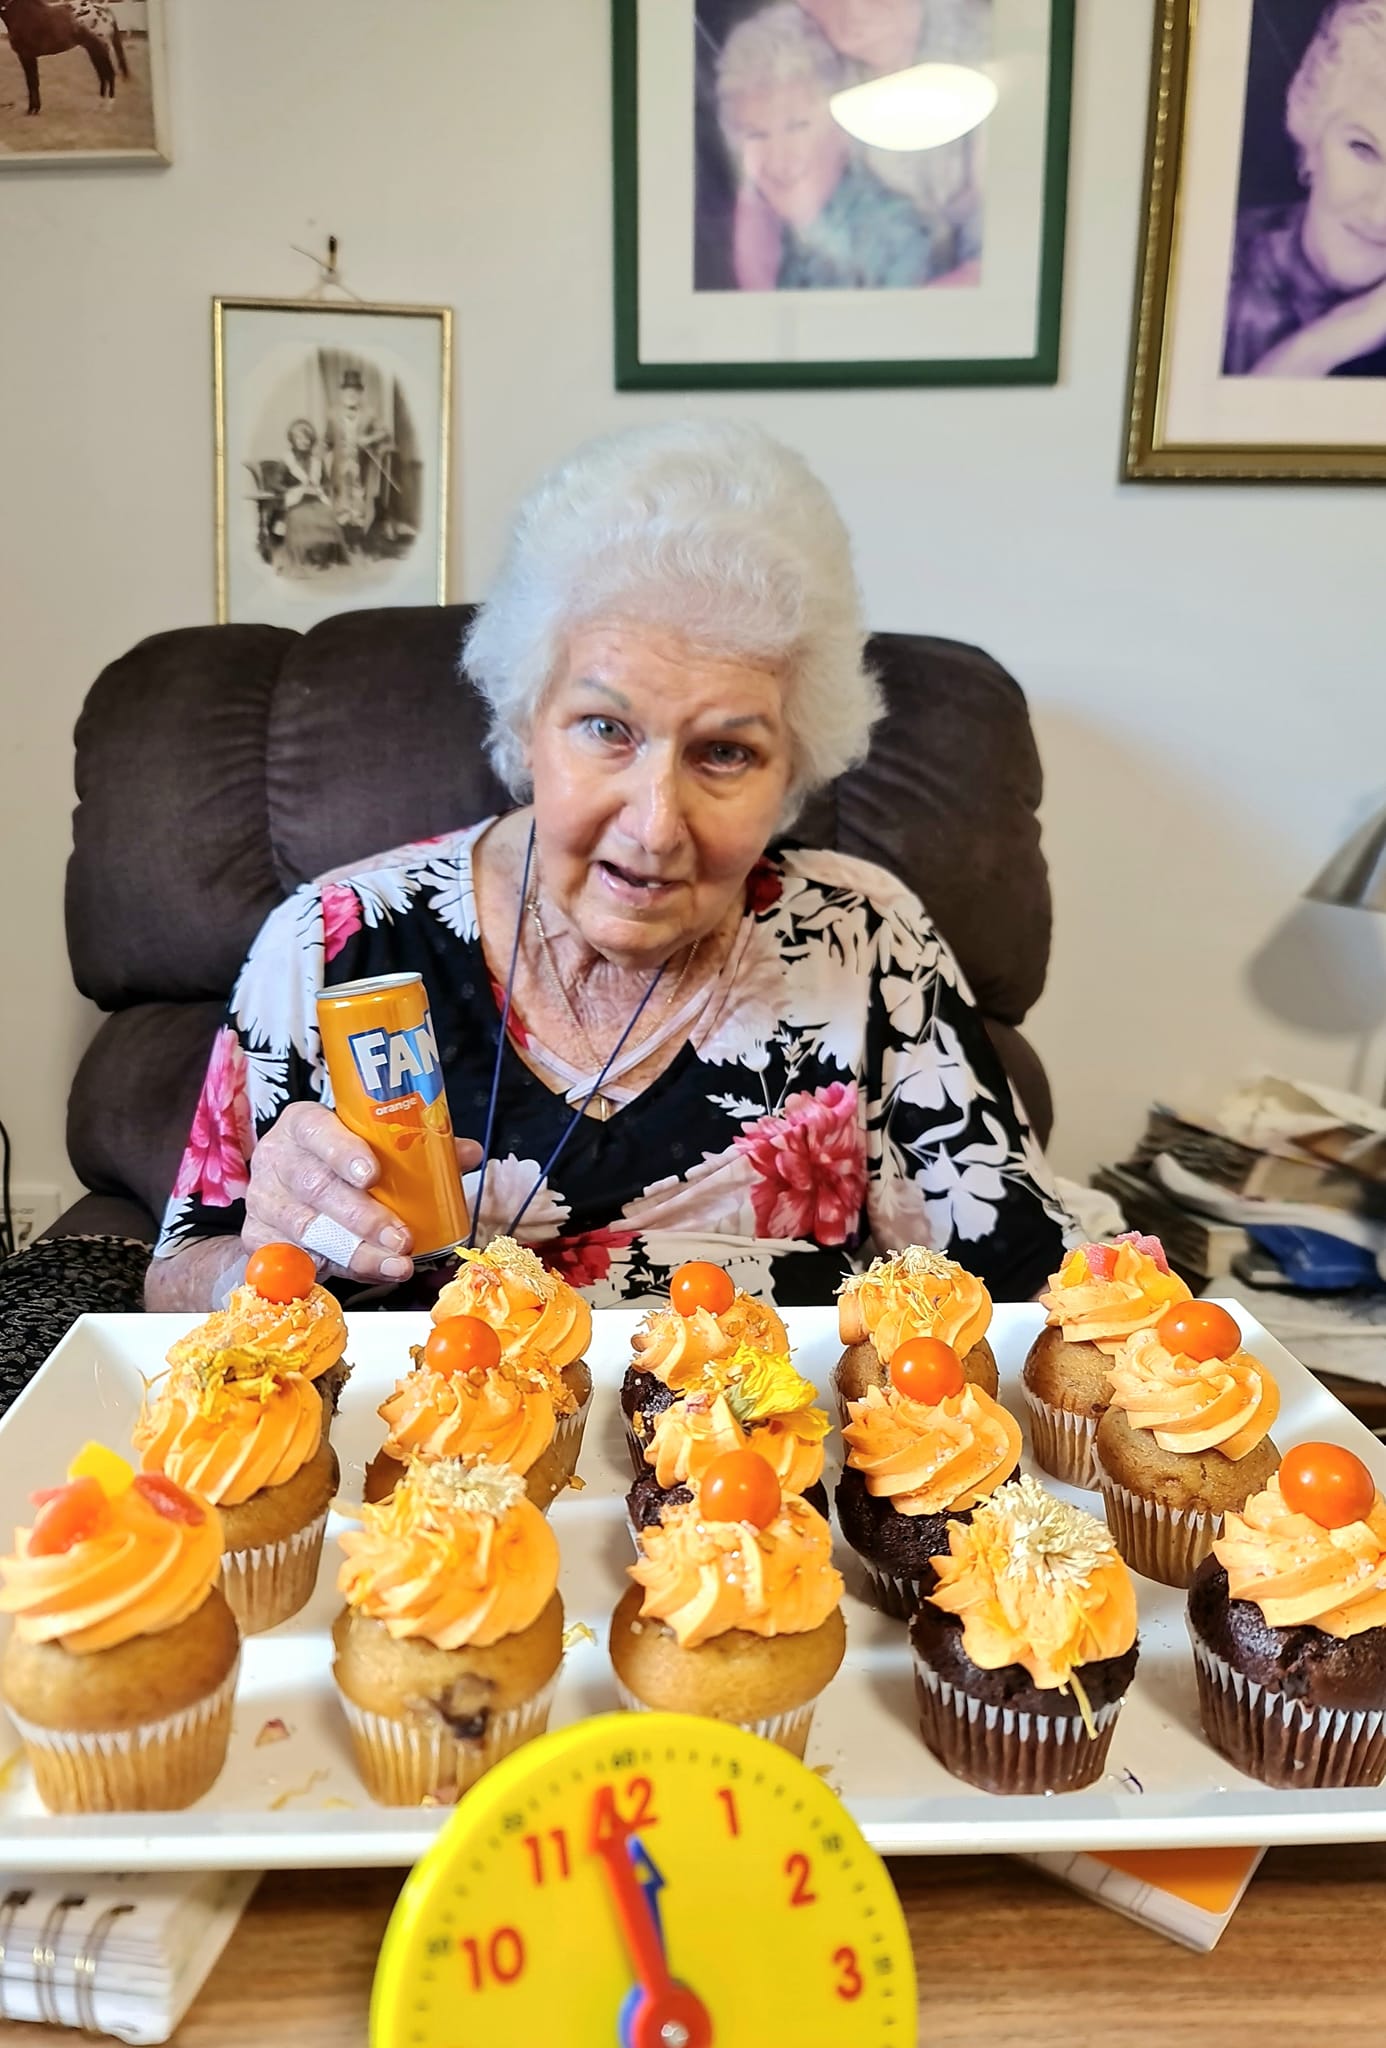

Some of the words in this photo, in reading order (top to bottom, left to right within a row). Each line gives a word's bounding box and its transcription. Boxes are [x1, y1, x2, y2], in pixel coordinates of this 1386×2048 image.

[352, 1011, 440, 1091] FAN
[375, 1097, 417, 1116] orange
[598, 1777, 658, 1838] 2
[717, 1787, 740, 1838] 1
[524, 1828, 570, 1885] 11
[785, 1852, 818, 1907] 2
[462, 1925, 526, 1992] 10
[833, 1946, 863, 2002] 3
